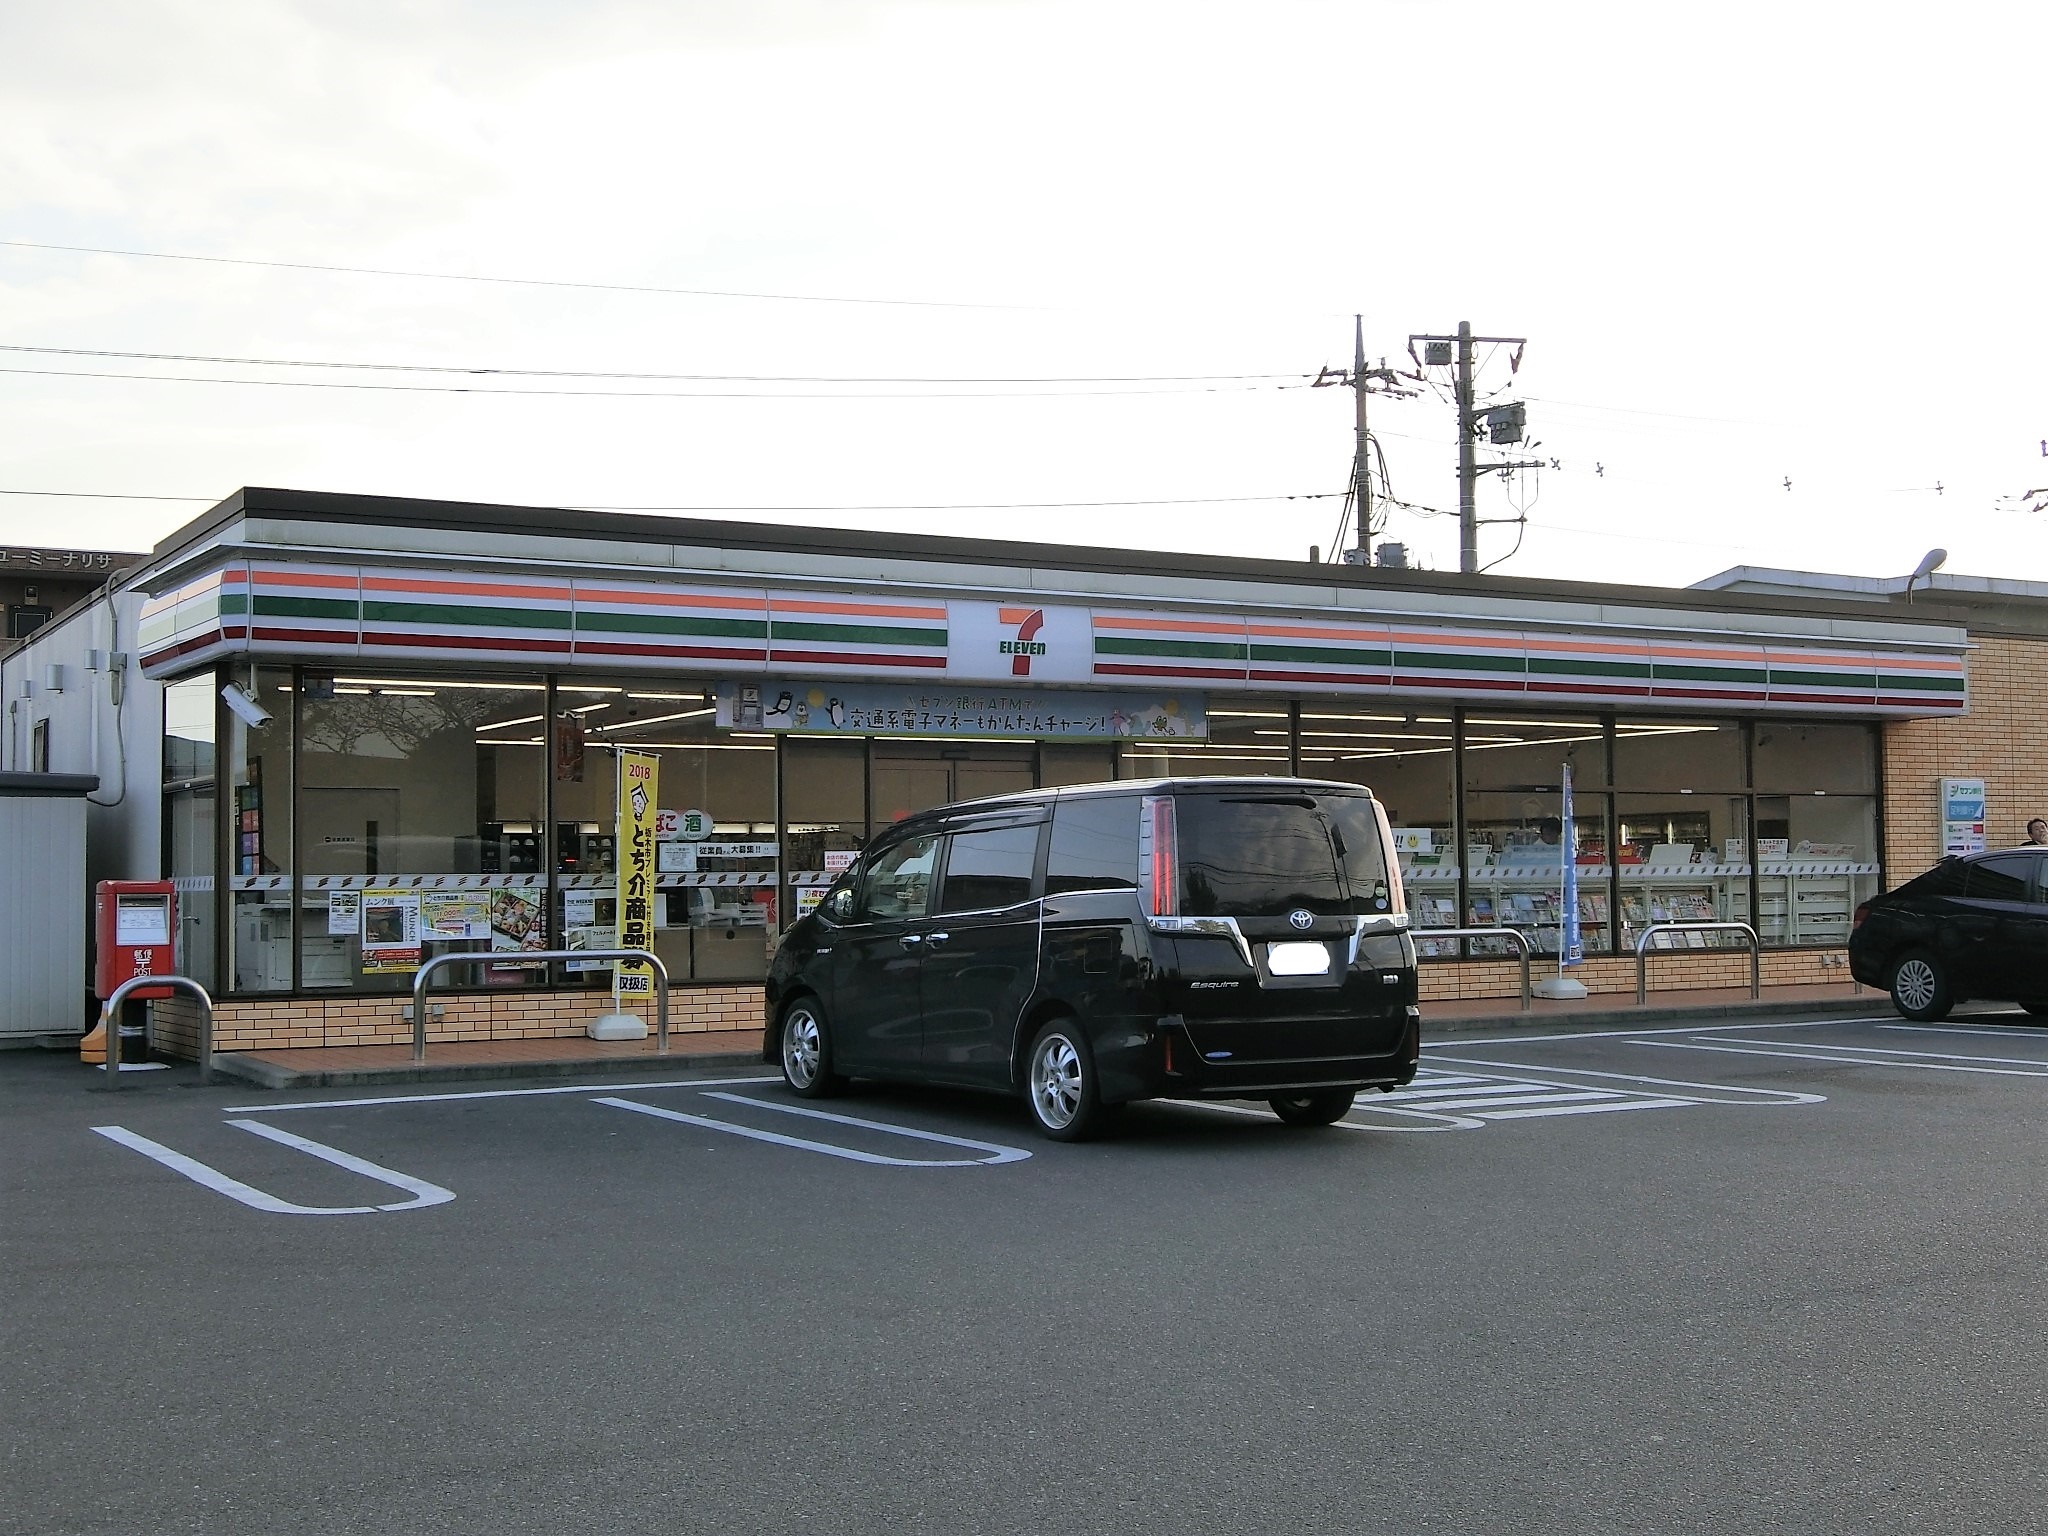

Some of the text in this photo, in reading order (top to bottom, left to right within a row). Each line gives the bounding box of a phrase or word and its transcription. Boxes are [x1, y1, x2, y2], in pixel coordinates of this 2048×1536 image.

[999, 607, 1044, 676] 7
[850, 708, 1106, 733] 交通系電子マネーもかんたんチャージ!
[629, 764, 651, 780] 2018
[684, 814, 702, 832] 酒
[365, 897, 395, 906] ムンク展
[409, 906, 418, 942] MUNCH
[133, 949, 153, 960] 郵便
[133, 967, 152, 976] POST
[1190, 980, 1240, 990] Esquire
